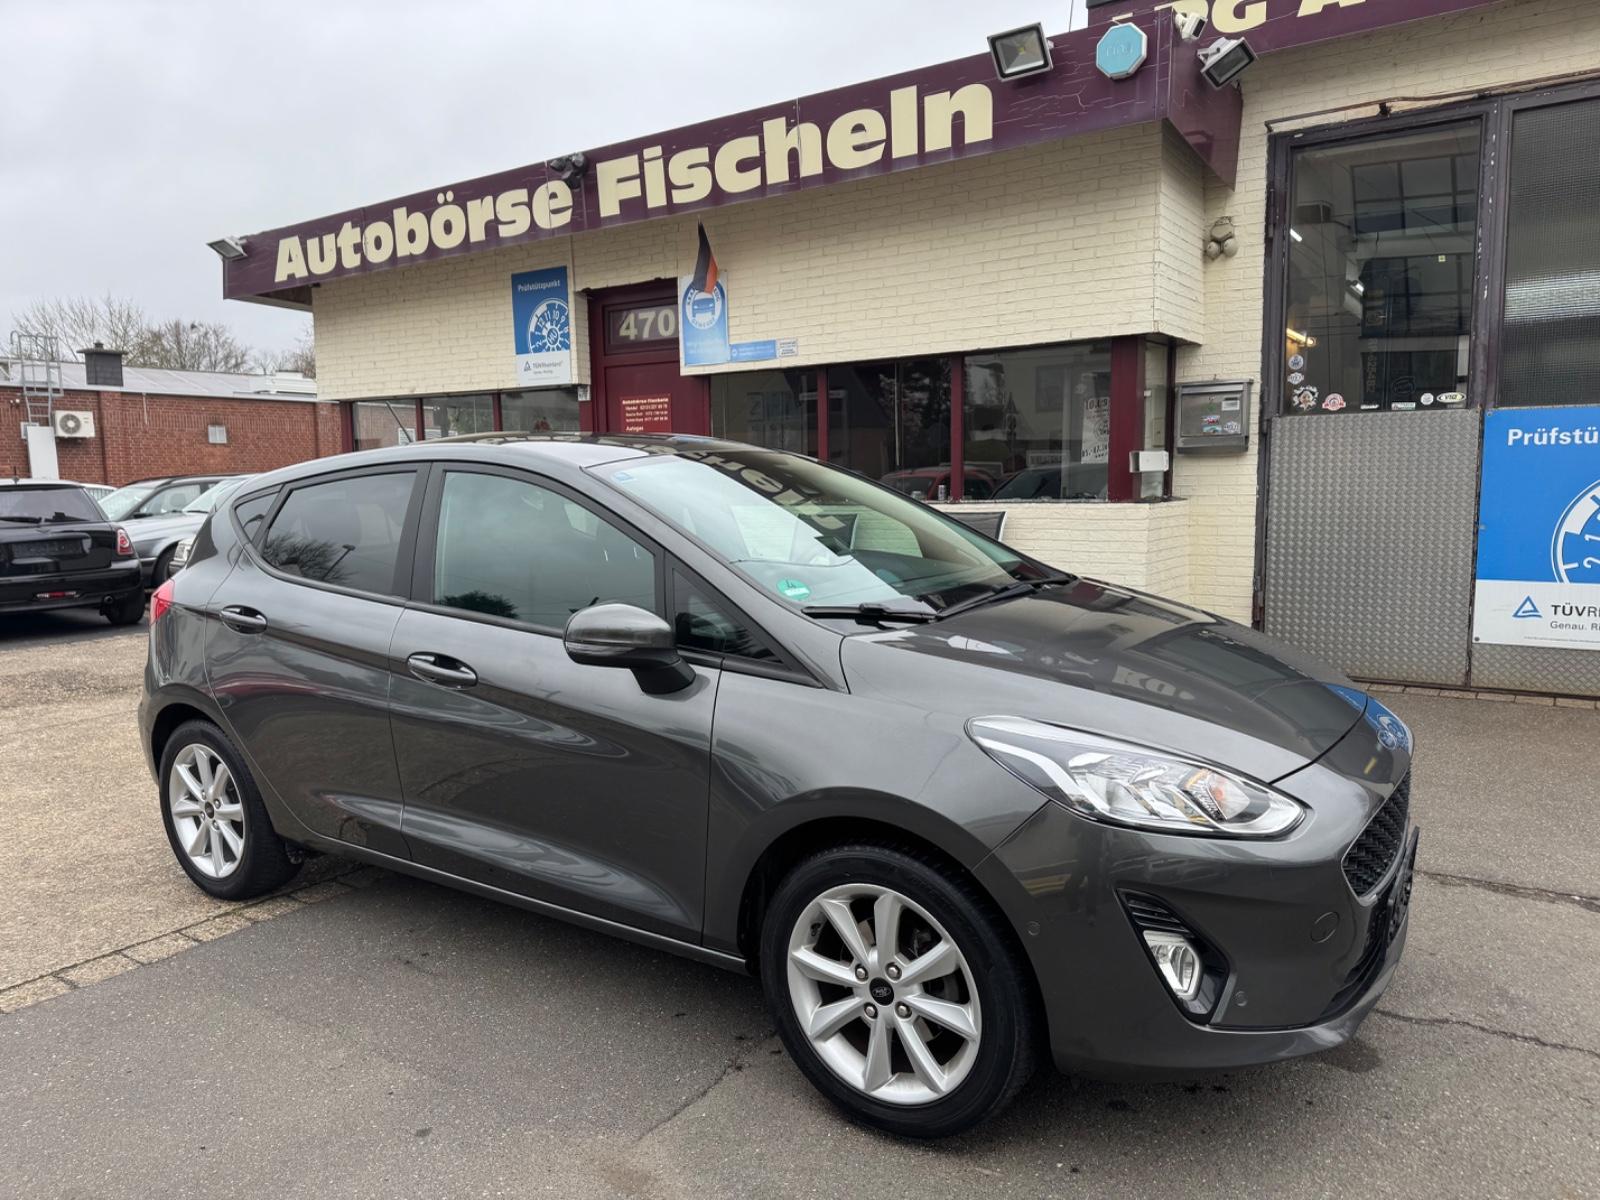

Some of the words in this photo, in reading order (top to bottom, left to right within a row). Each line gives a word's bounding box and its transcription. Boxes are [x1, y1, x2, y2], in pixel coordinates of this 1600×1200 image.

[274, 180, 574, 283] Autobörse
[596, 83, 994, 218] Fischeln
[619, 309, 677, 341] 470
[1508, 425, 1598, 446] Prüfstü
[1550, 621, 1587, 631] Genau.
